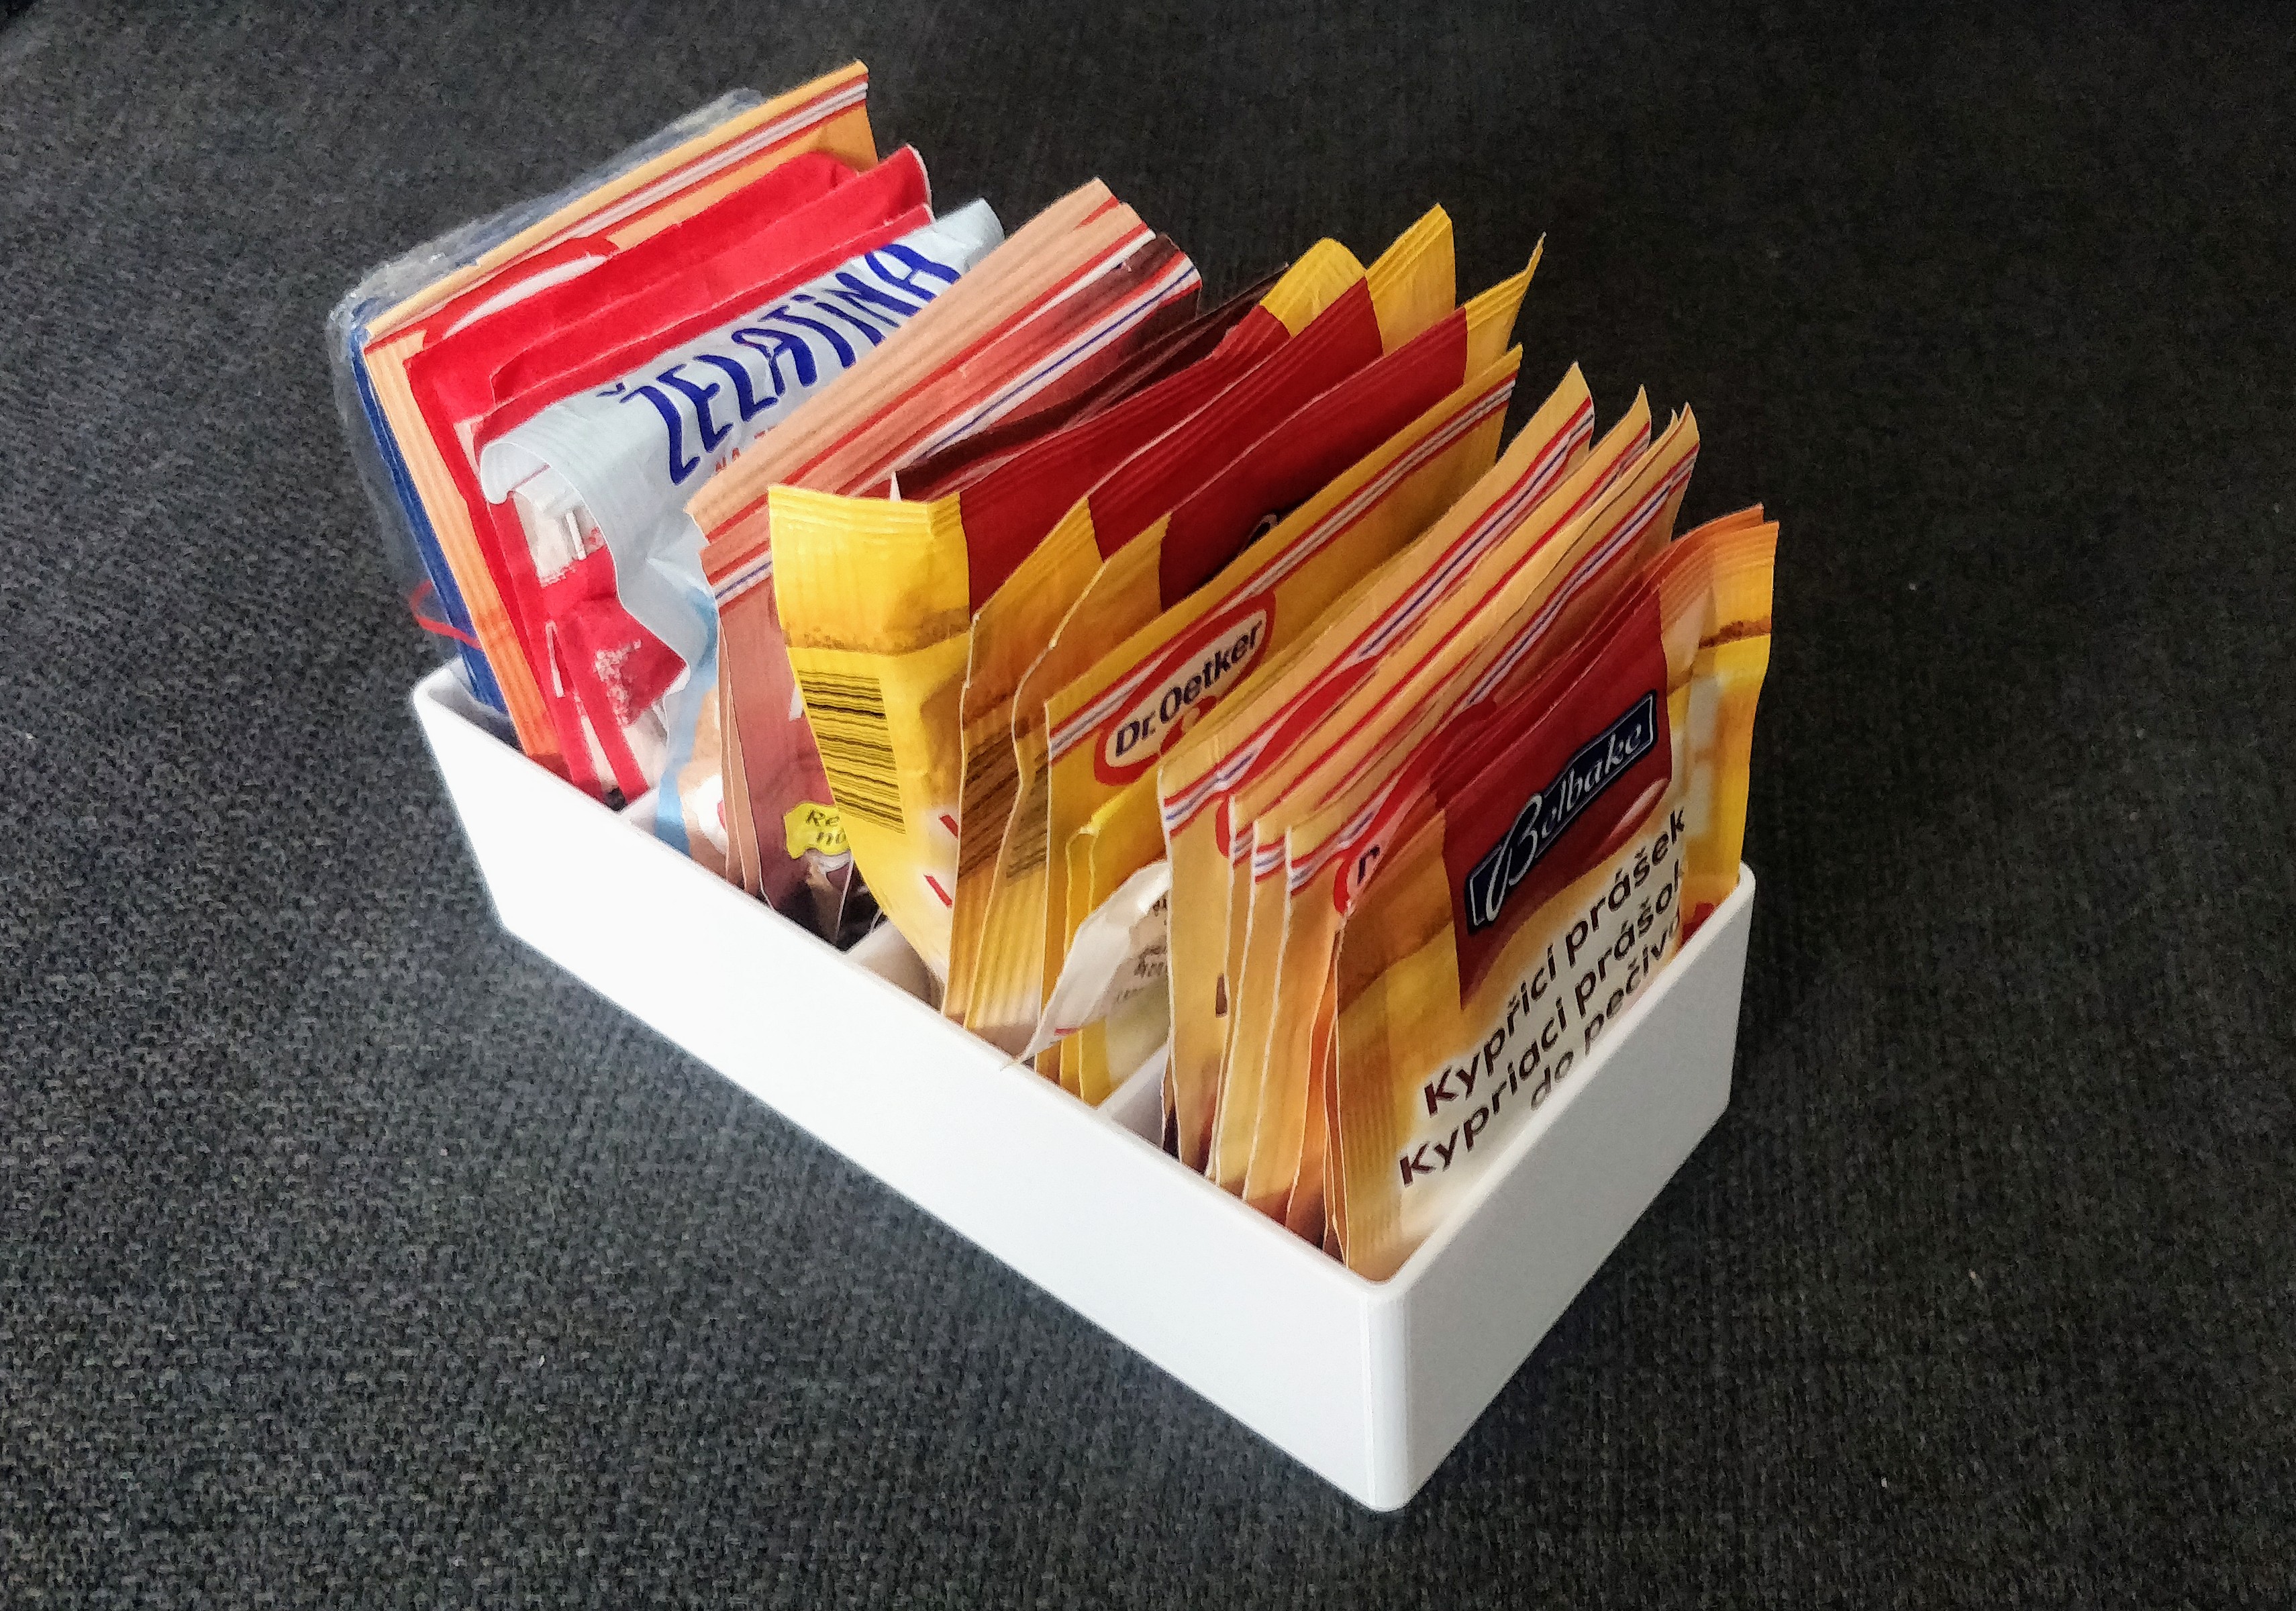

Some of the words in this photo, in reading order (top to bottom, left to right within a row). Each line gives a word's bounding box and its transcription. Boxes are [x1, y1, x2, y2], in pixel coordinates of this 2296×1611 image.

[1485, 724, 1642, 922] Belbake
[1565, 807, 1685, 968] prášek
[1399, 995, 1567, 1187] Kypriaci
[1531, 1051, 1574, 1111] do
